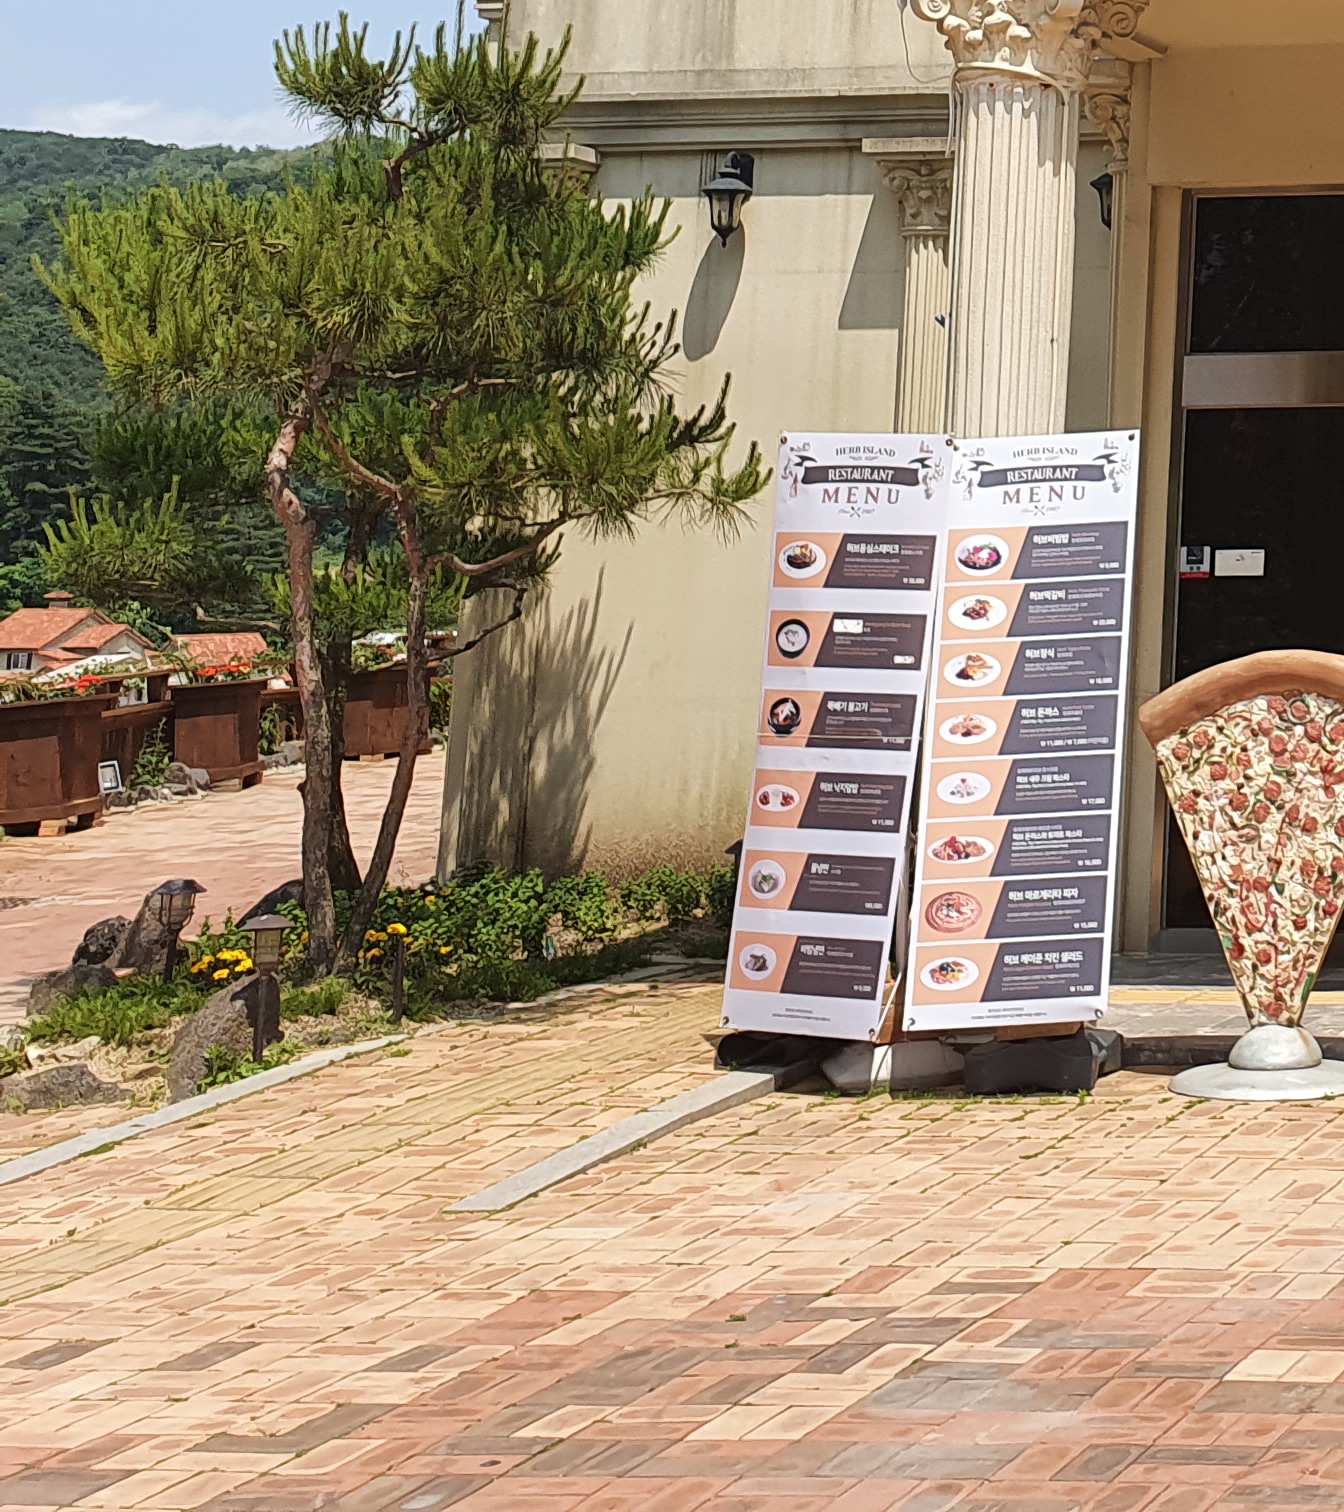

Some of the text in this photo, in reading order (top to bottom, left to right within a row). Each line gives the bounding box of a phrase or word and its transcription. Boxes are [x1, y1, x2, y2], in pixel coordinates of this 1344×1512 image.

[835, 445, 897, 458] HERB ISLAND
[1012, 446, 1078, 459] HERB ISLAND
[828, 468, 895, 483] RESTAURANT
[1006, 467, 1080, 483] RESTAURANT
[821, 486, 900, 505] MENU
[1002, 484, 1086, 505] MENU
